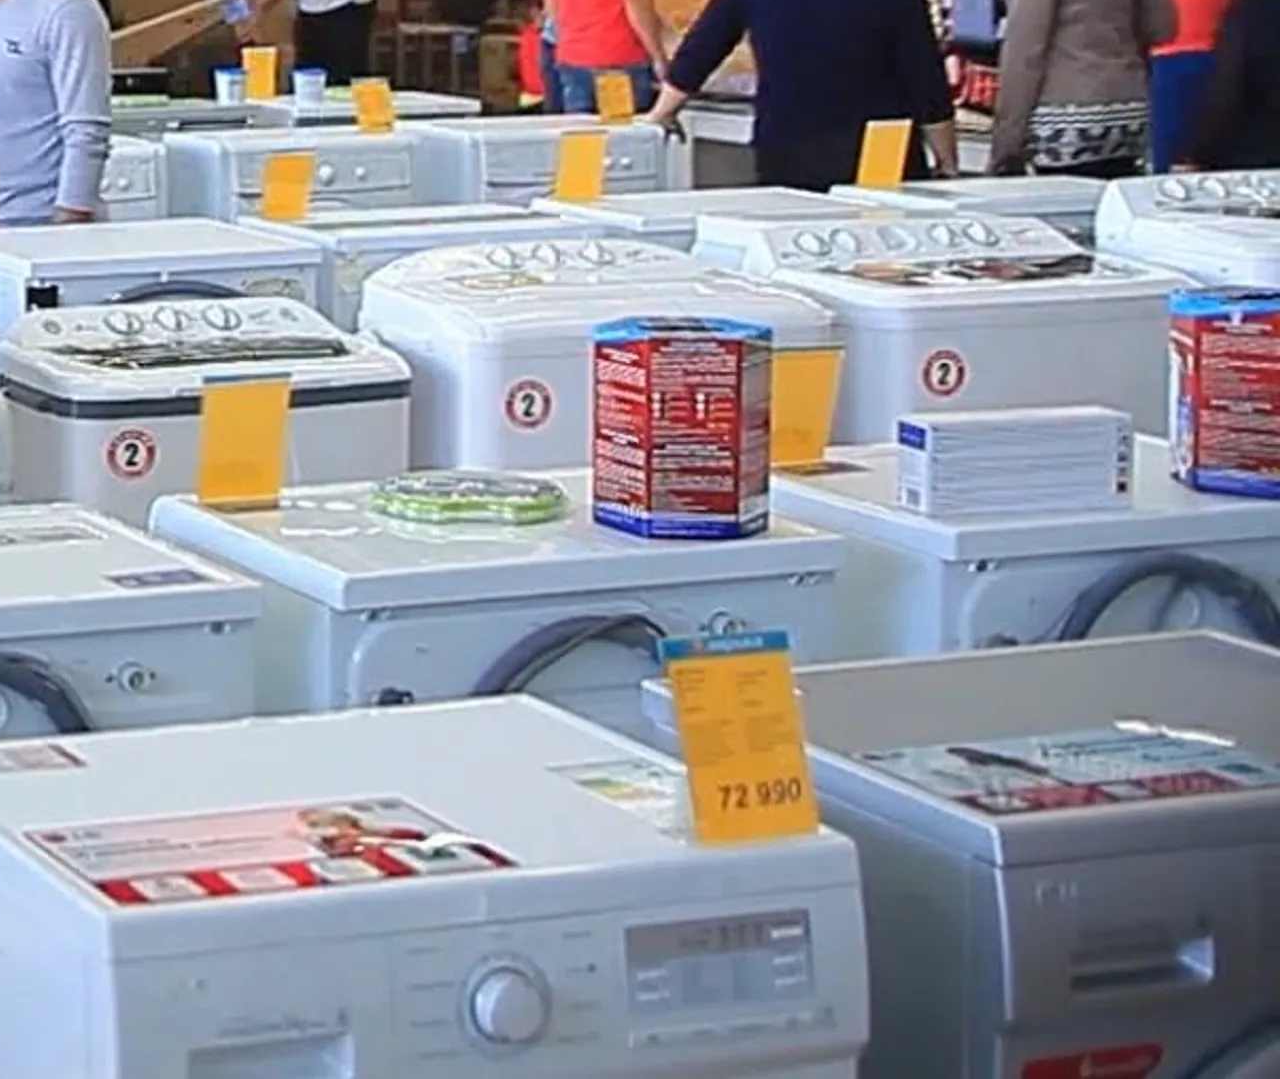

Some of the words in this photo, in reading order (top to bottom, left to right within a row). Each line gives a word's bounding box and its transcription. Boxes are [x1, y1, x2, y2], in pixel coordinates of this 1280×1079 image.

[938, 362, 951, 386] 2
[521, 392, 536, 417] 2
[124, 442, 139, 467] 2
[718, 782, 749, 811] 72
[755, 776, 801, 806] 990
